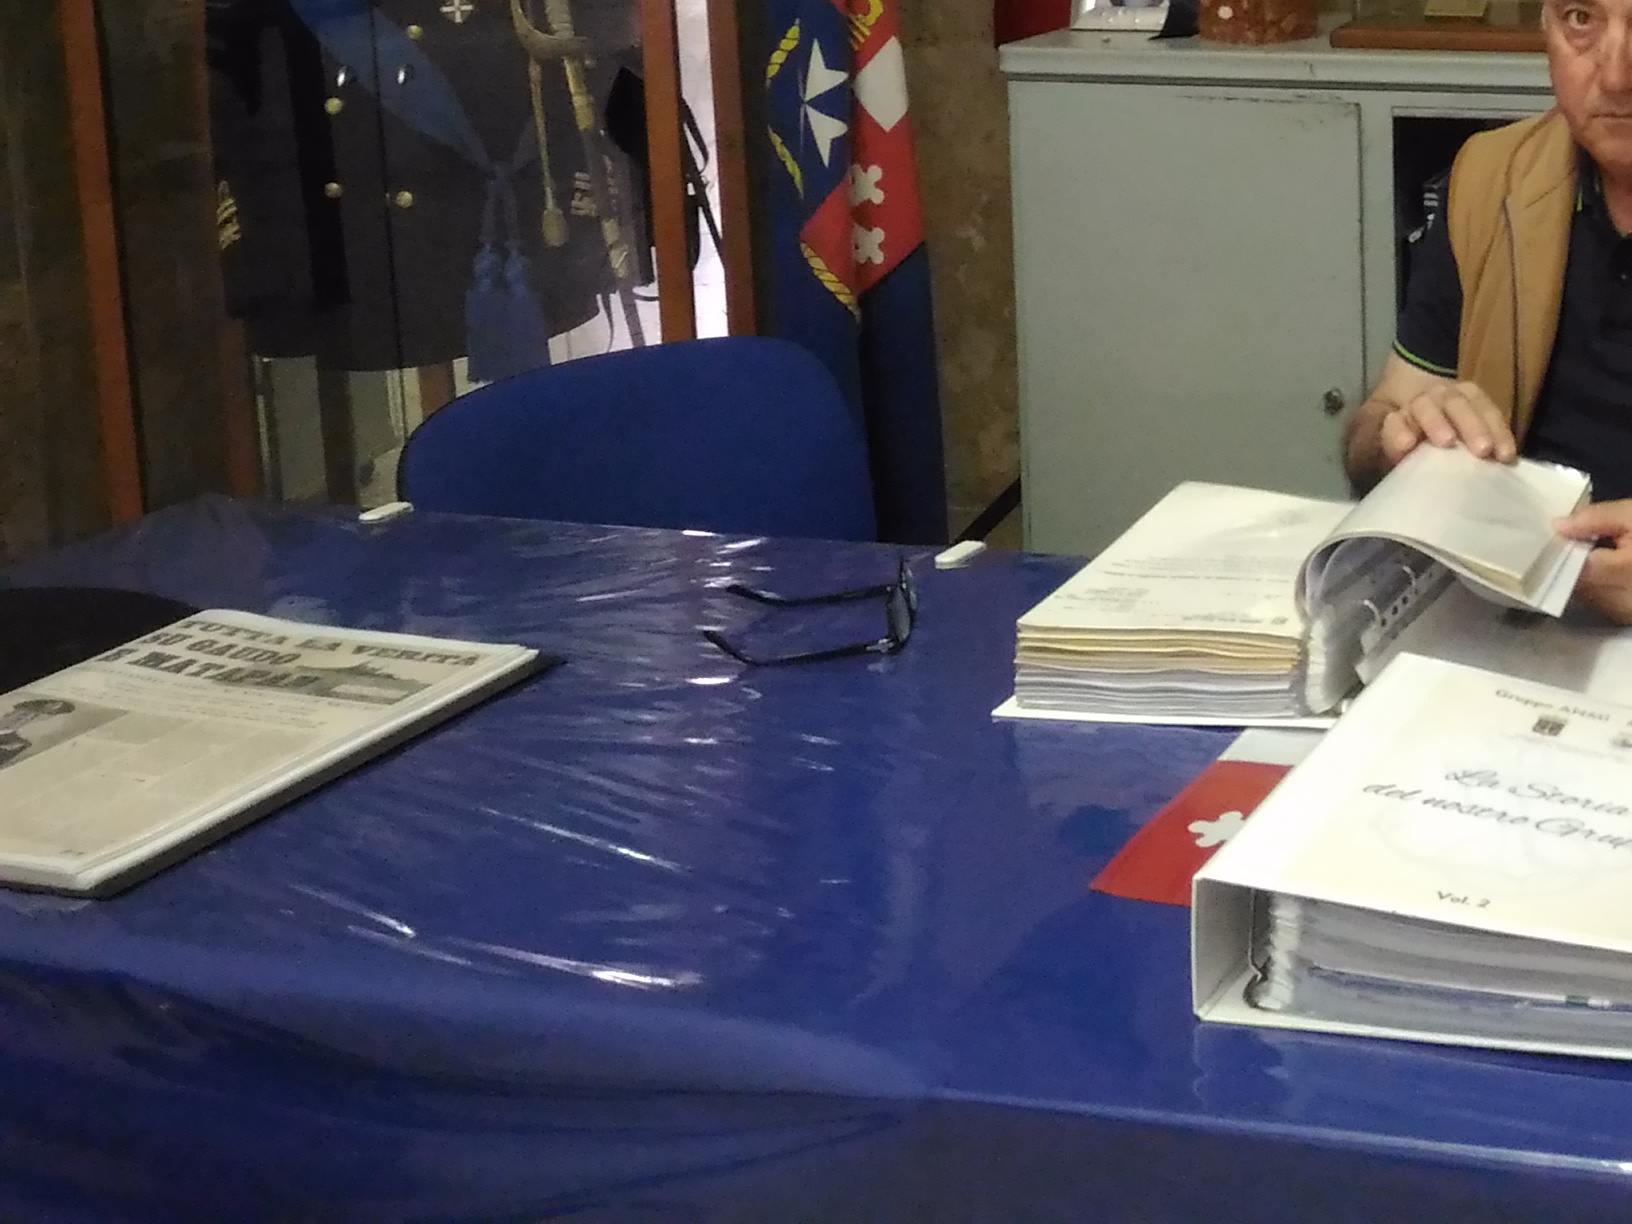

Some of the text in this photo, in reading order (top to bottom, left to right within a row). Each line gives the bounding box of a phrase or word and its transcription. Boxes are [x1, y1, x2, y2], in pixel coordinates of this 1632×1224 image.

[1362, 783, 1423, 801] del
[1422, 796, 1530, 825] nostro
[1444, 769, 1630, 816] La Storia
[1437, 889, 1491, 909] Vol. 2
